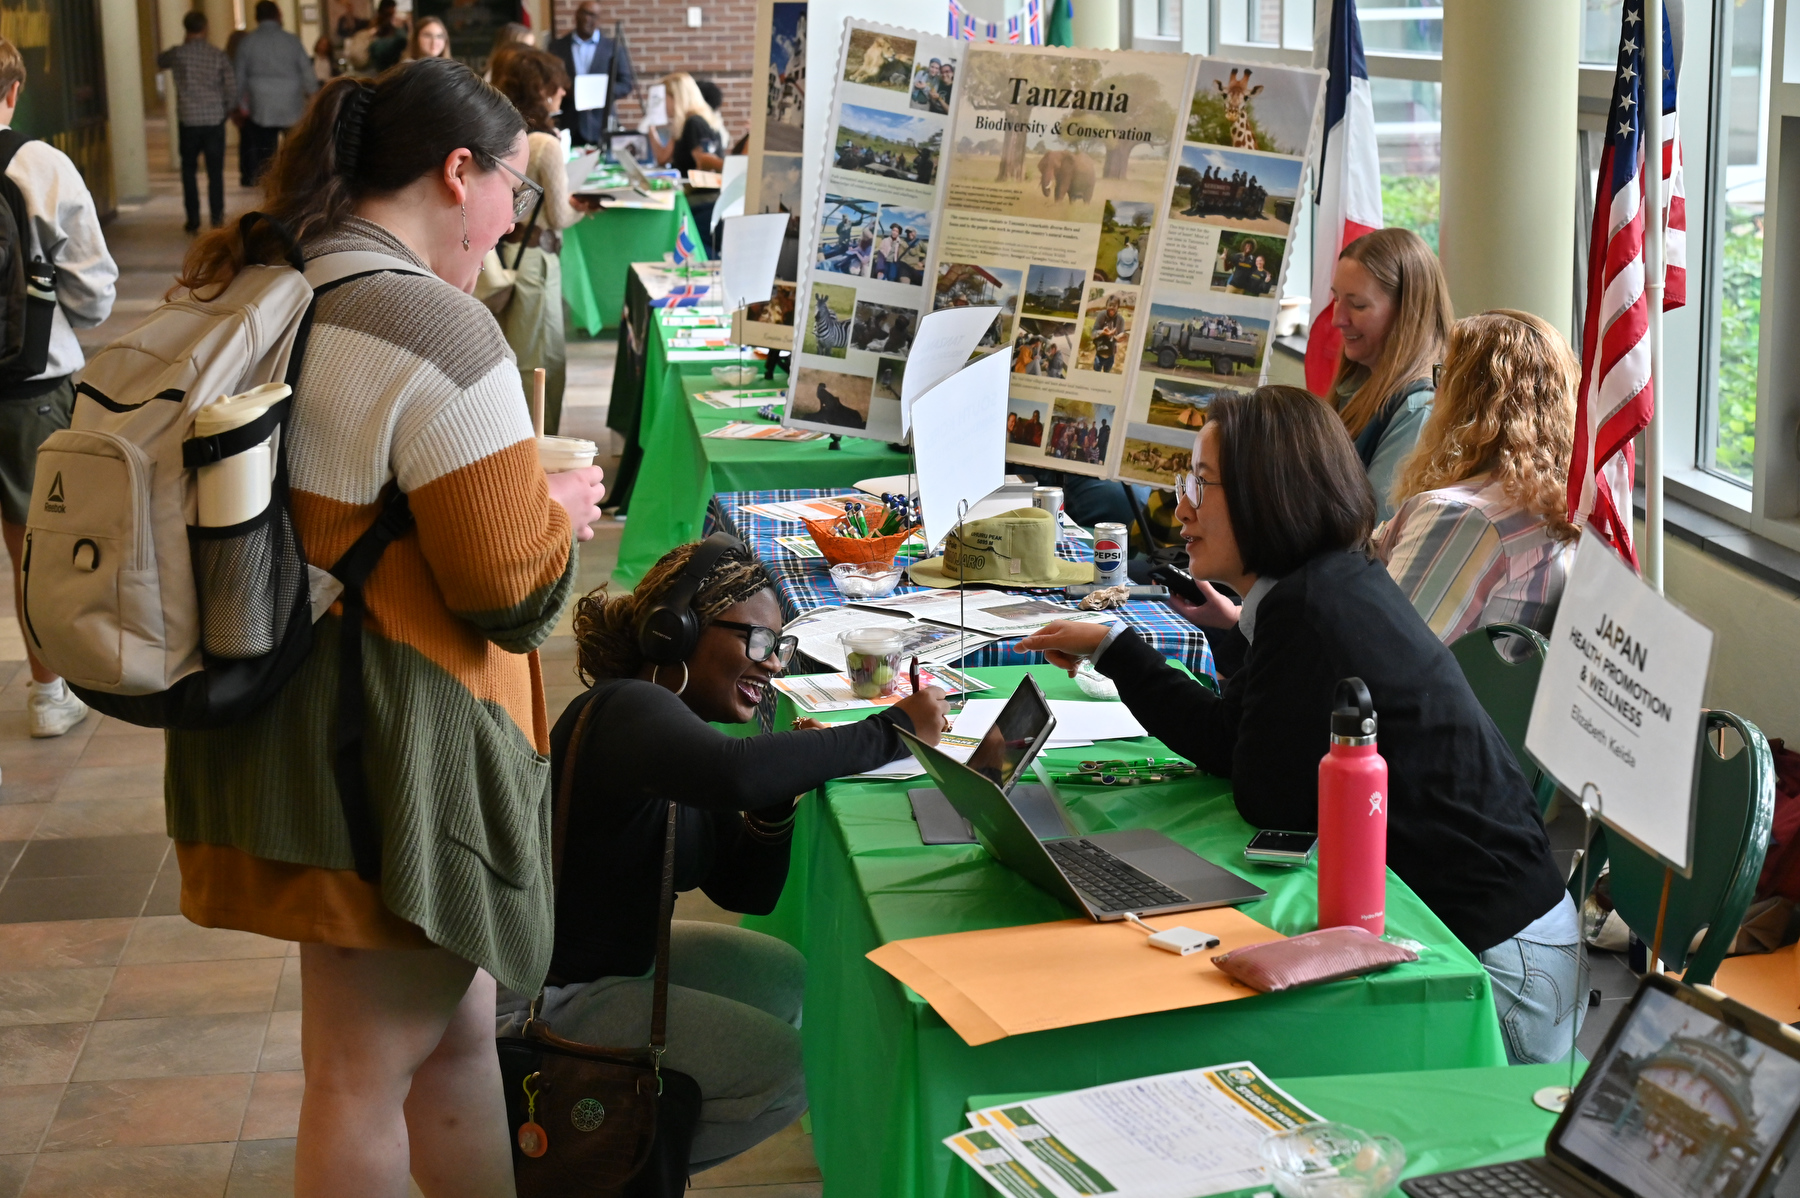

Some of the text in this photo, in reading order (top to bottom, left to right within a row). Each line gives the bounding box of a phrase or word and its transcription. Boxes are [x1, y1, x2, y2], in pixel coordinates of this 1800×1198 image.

[1008, 77, 1129, 113] Tanzania
[975, 116, 1152, 142] Biodiversity & Conservation
[44, 502, 66, 513] Reebok
[988, 533, 1003, 541] PEAK
[1094, 551, 1121, 559] PEPSI
[1595, 614, 1648, 672] JAPAN
[1569, 626, 1673, 722] HEALTH PROMOTION
[1579, 665, 1643, 728] & WELLNESS
[1570, 704, 1608, 746] Elizabeth
